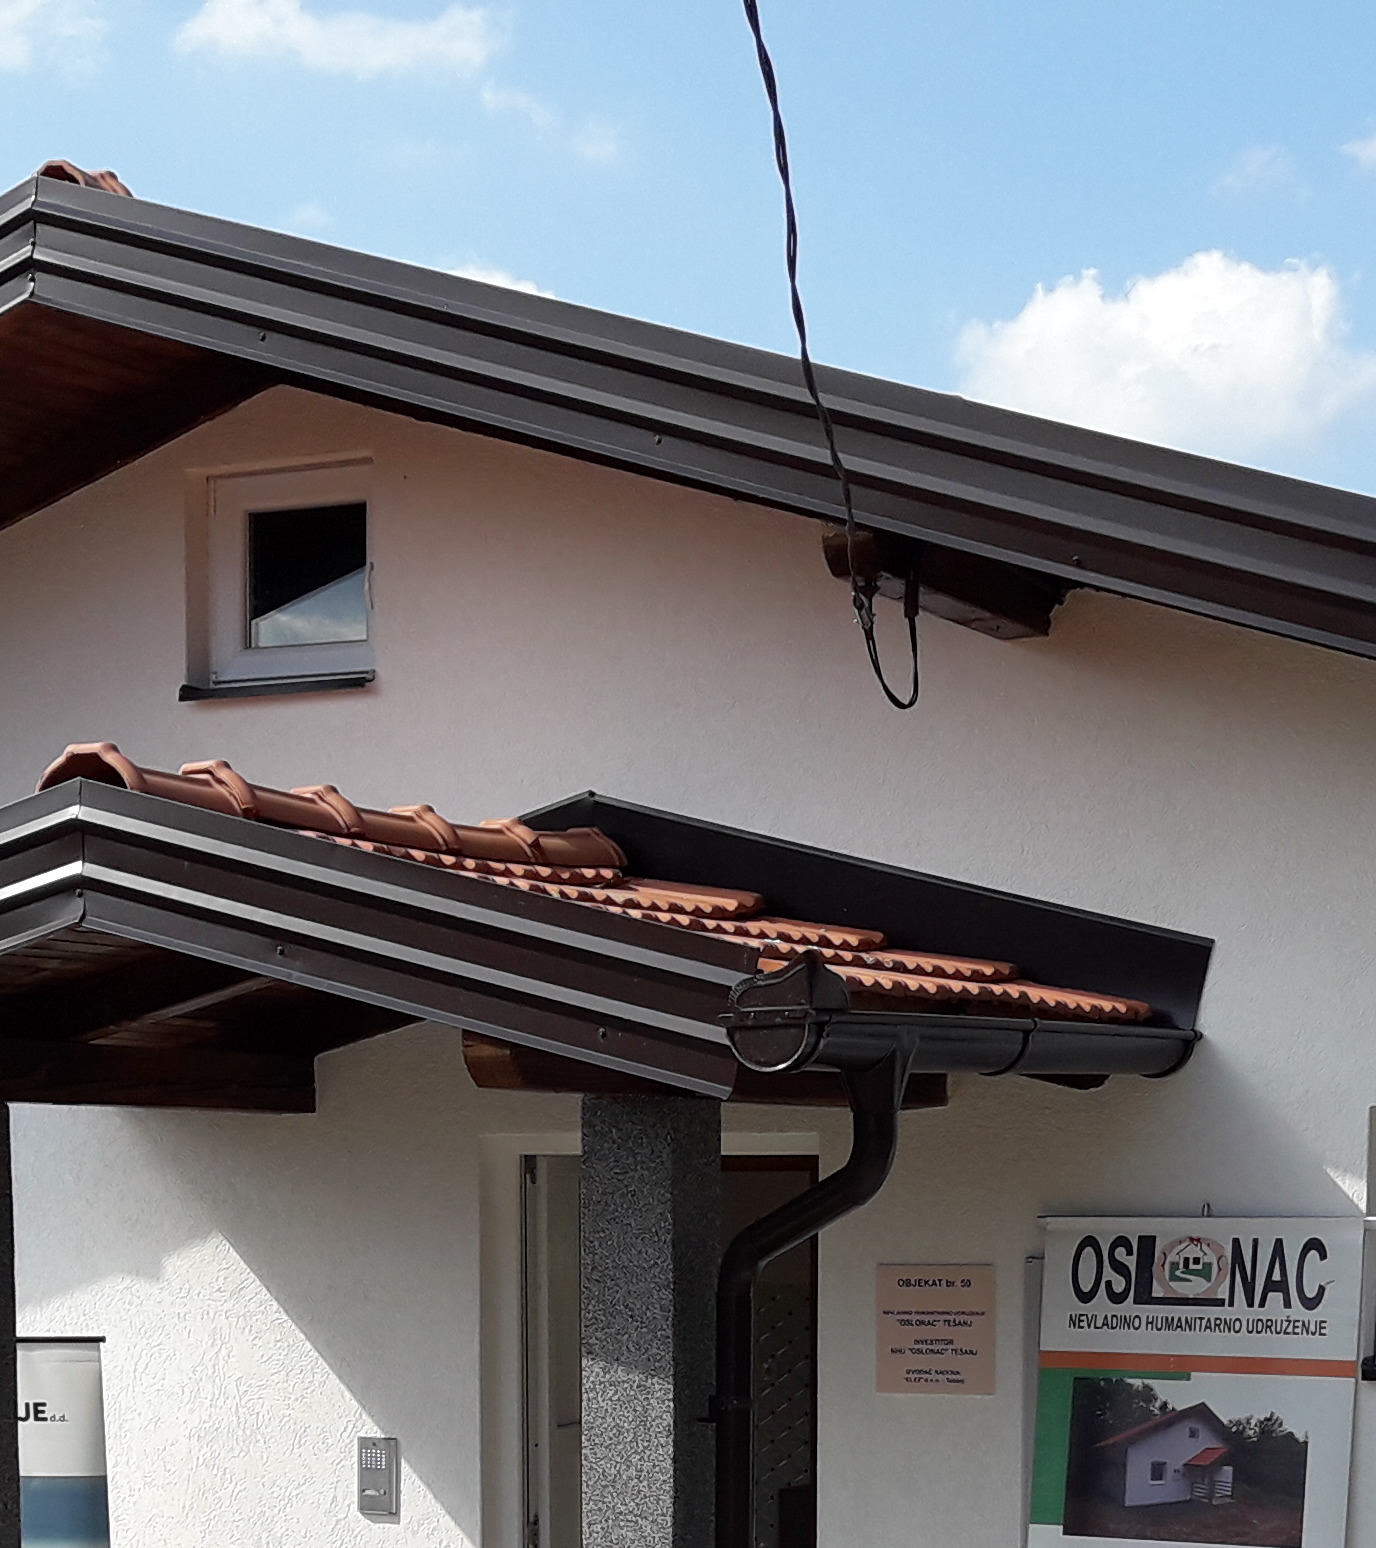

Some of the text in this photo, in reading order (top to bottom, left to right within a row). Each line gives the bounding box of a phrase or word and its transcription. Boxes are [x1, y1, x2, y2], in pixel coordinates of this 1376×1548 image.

[897, 1278, 943, 1288] OBJEKAT
[1068, 1313, 1328, 1337] NEVLADINO HUMANITARNO UDRUŽENJE
[17, 1402, 69, 1422] JE d.d.
